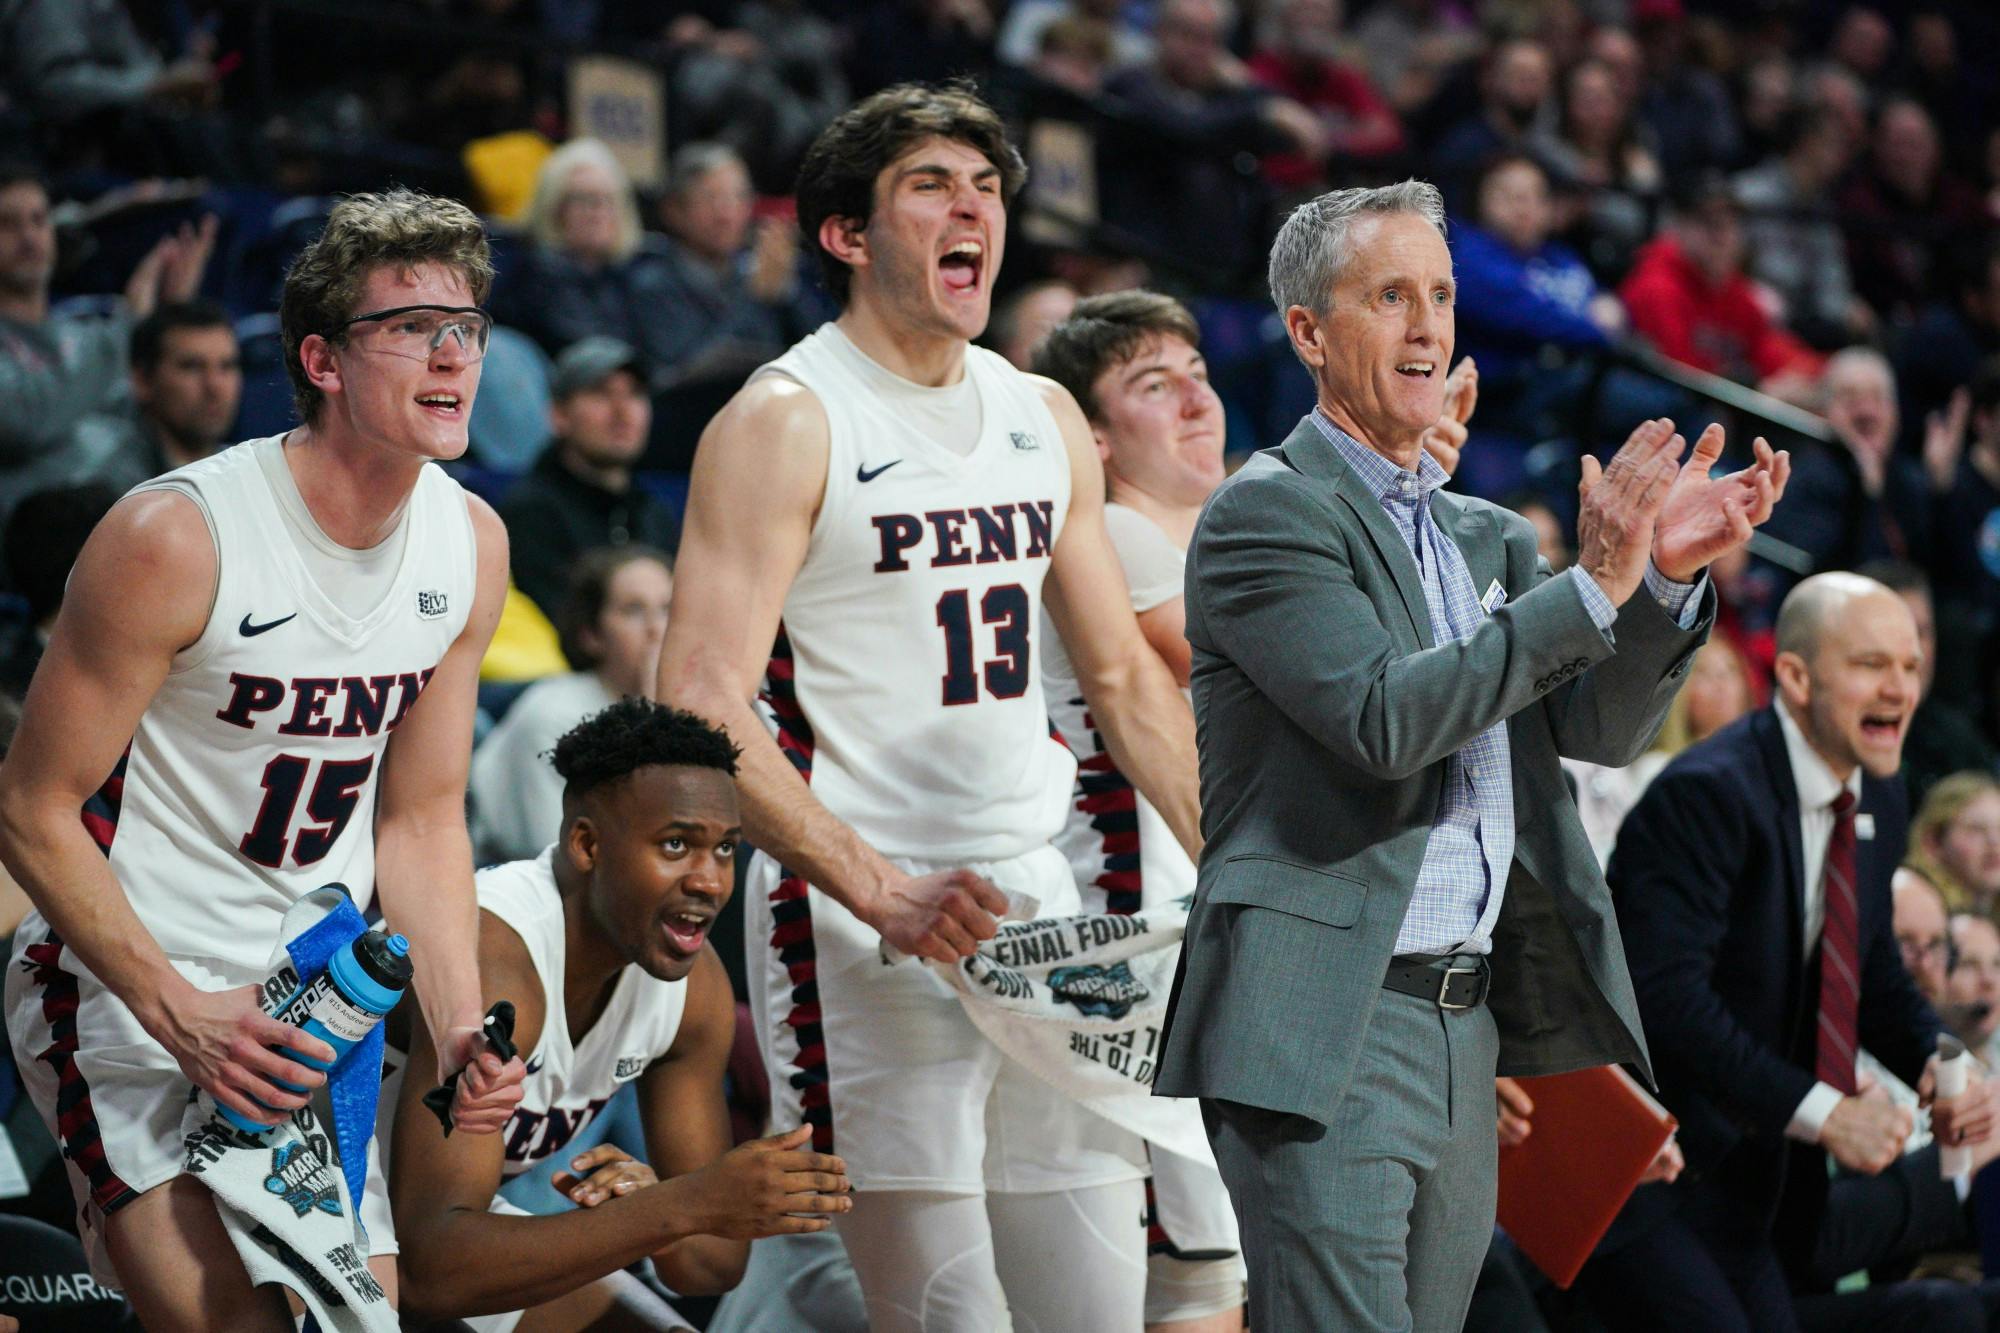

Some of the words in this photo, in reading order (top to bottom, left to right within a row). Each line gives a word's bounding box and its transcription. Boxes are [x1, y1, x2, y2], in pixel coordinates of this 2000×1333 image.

[871, 499, 1054, 573] PENN
[936, 583, 1030, 706] 13
[238, 752, 374, 868] 15
[994, 929, 1074, 967] FINAL
[1107, 1046, 1131, 1076] TO
